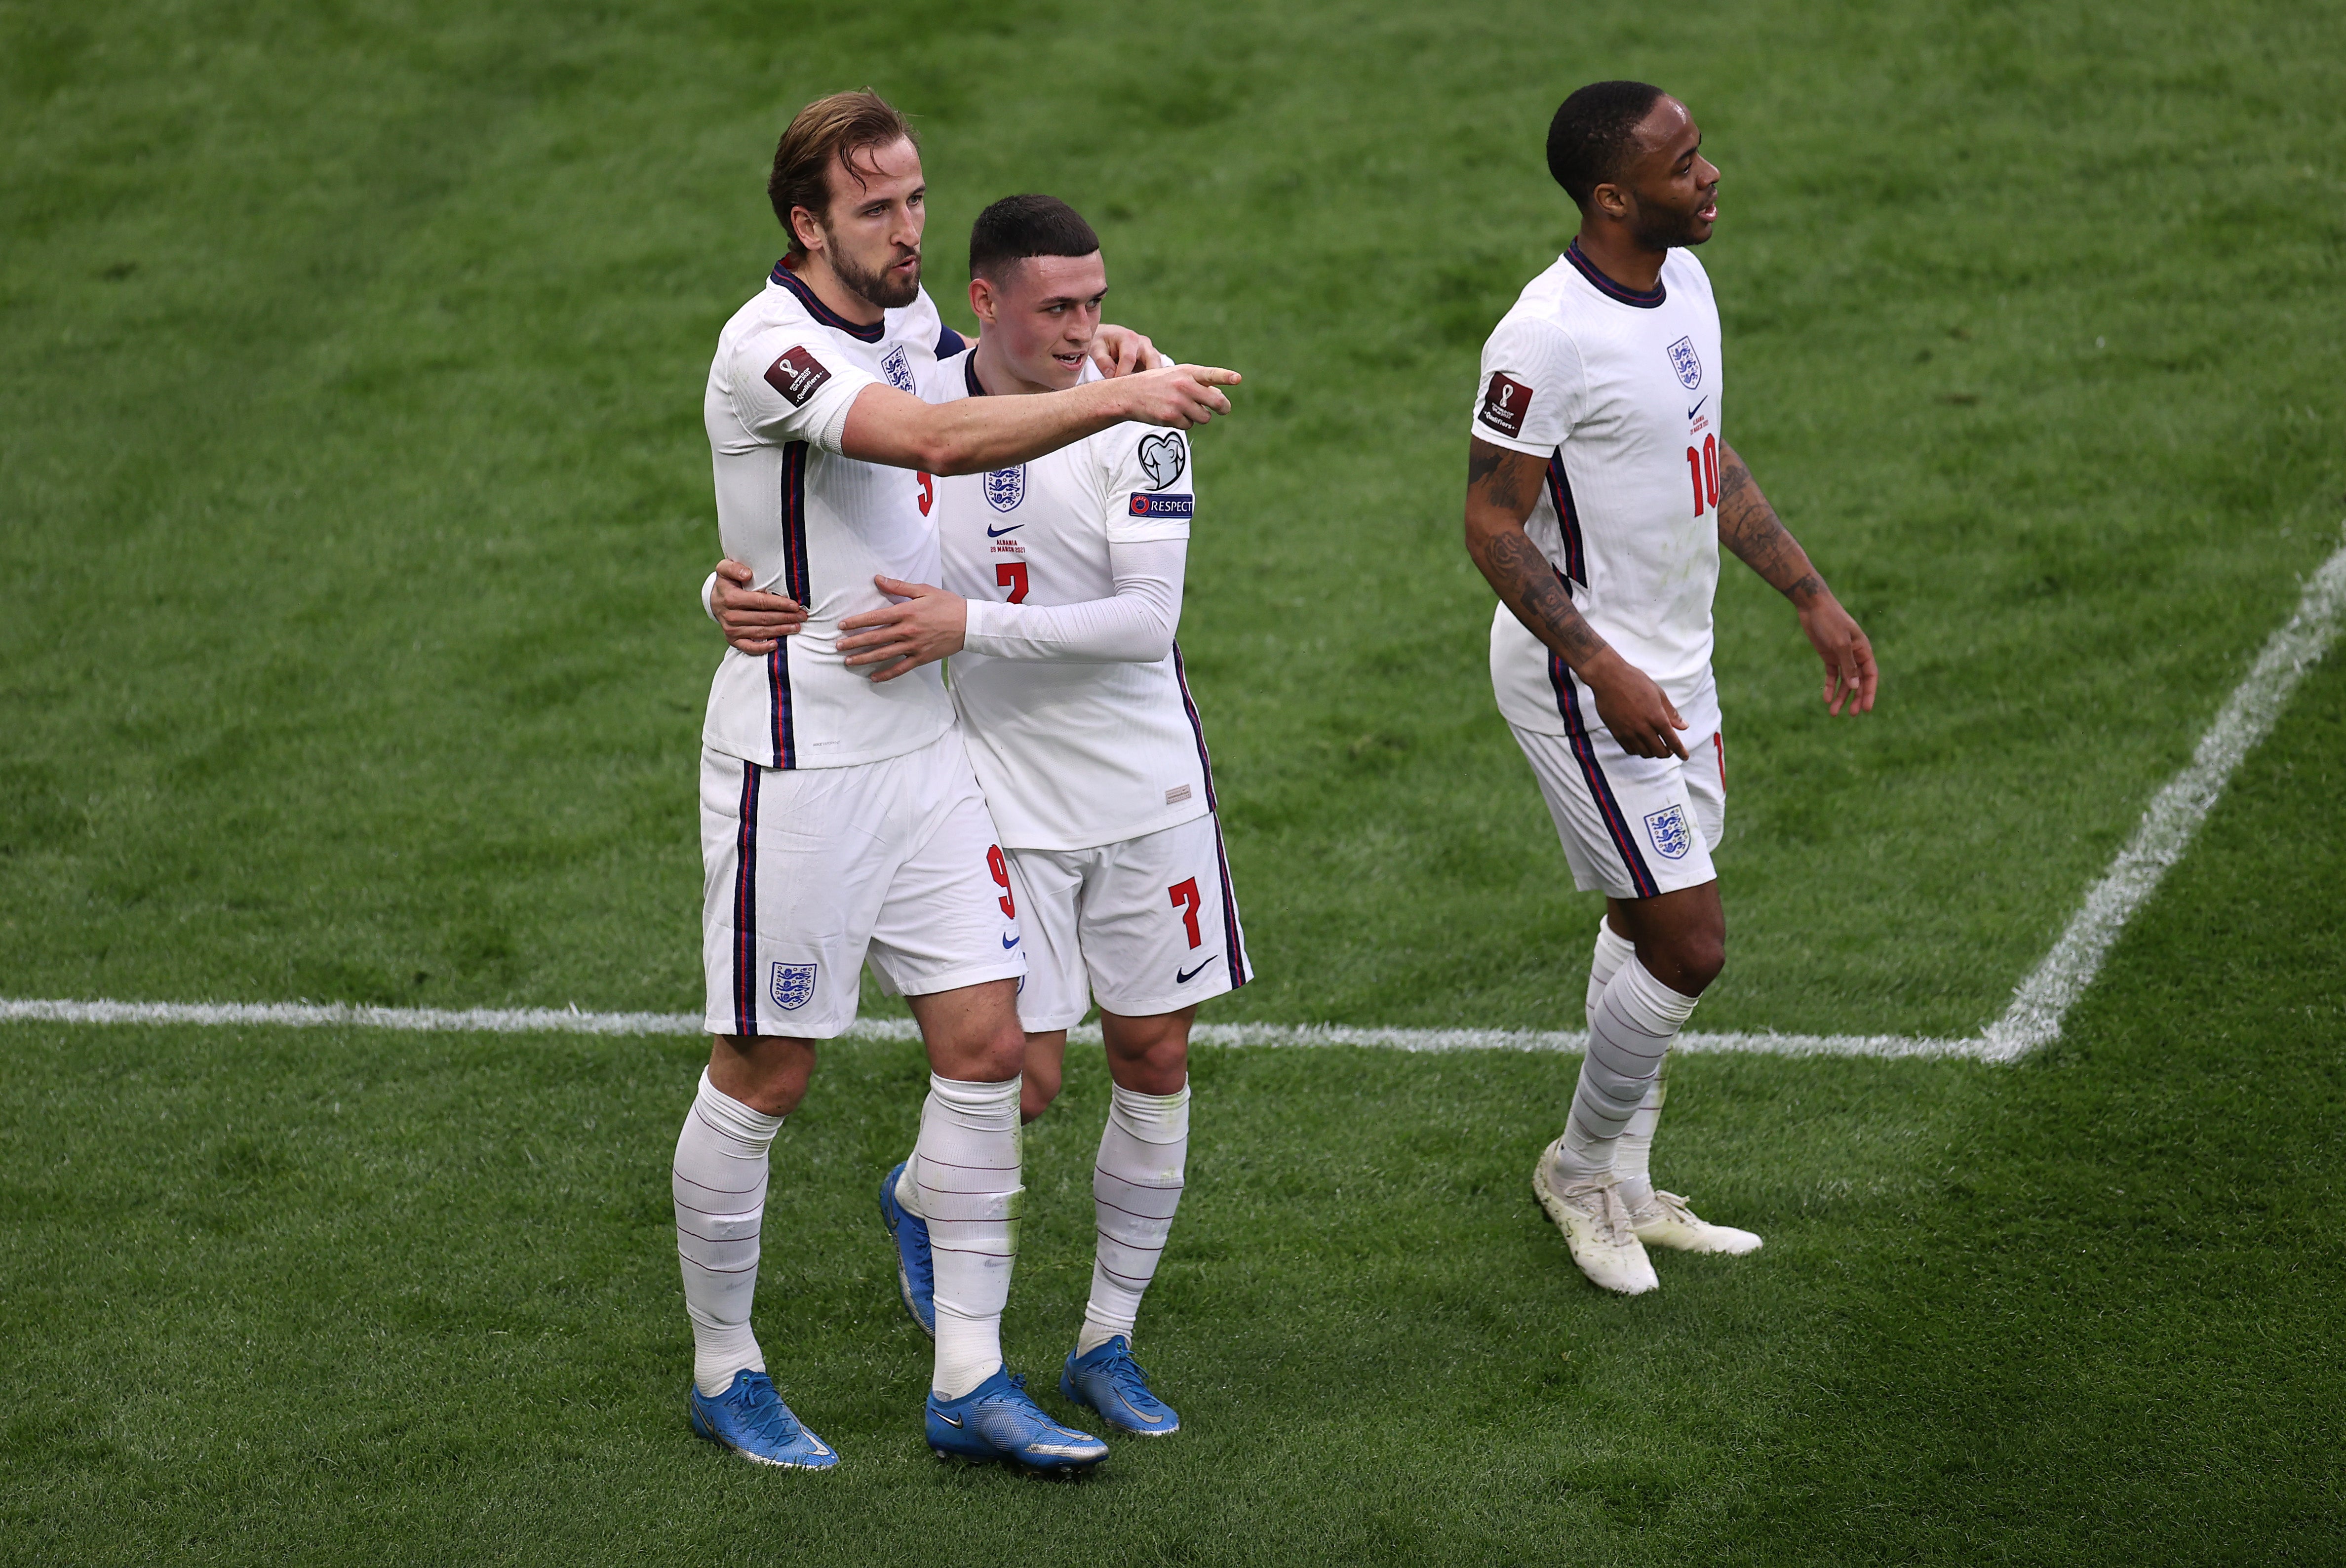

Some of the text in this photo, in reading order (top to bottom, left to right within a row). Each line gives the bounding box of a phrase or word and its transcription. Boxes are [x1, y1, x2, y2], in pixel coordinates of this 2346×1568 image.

[797, 374, 821, 400] Qualifiers
[1486, 411, 1512, 430] Qualifiers
[1687, 432, 1720, 517] 10
[1151, 501, 1192, 511] RESPECT
[995, 562, 1029, 605] 7
[986, 844, 1015, 920] 9
[1168, 876, 1201, 950] 7
